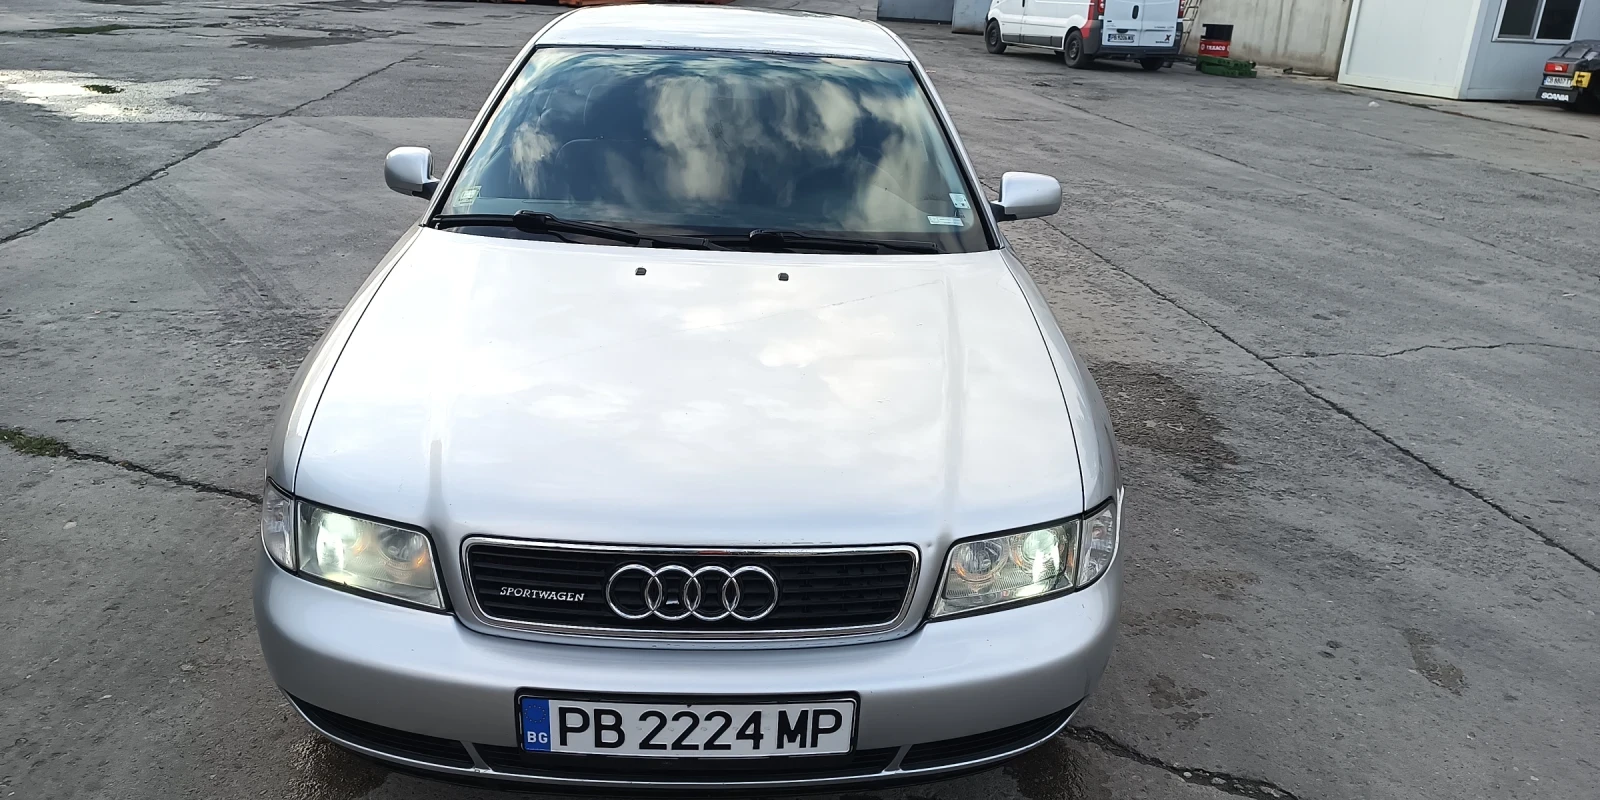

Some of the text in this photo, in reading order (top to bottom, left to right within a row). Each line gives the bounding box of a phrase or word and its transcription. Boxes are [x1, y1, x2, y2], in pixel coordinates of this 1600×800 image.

[1541, 92, 1569, 101] SCANIA
[500, 586, 585, 601] SPORTWAGEN
[558, 706, 843, 751] PB 2224 MP
[527, 731, 548, 744] BG
